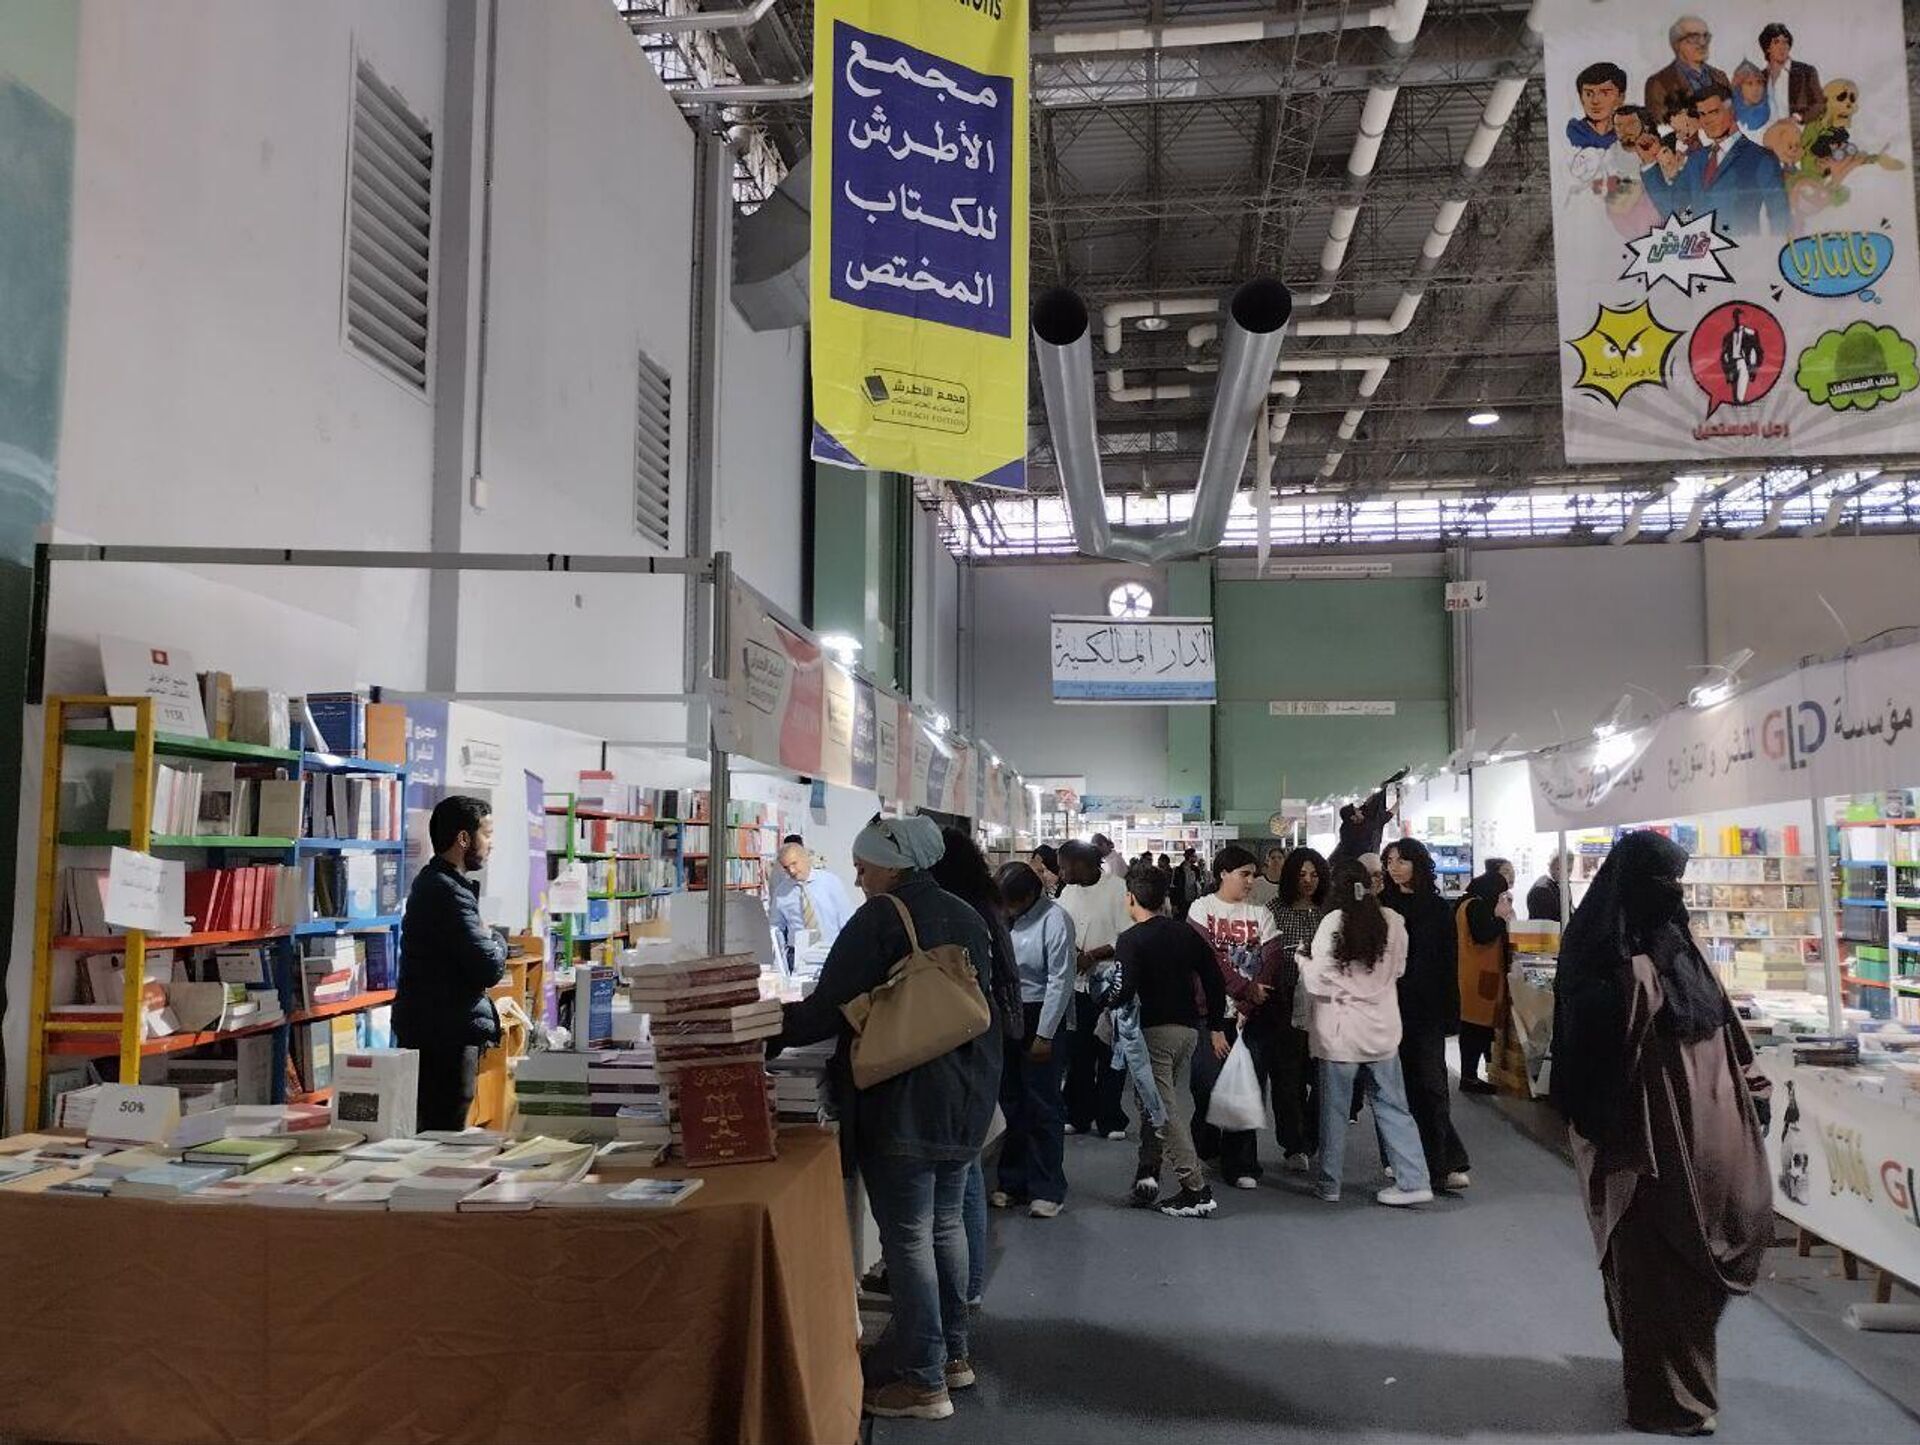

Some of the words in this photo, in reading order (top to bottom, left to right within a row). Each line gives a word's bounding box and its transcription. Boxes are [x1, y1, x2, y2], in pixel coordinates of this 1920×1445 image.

[845, 39, 998, 109] مجمع
[848, 104, 995, 174] الأطرش
[844, 179, 998, 241] للكتاب
[845, 255, 994, 309] المختص
[1788, 231, 1877, 286] فانتازيا
[1447, 598, 1470, 609] RIA
[1056, 627, 1154, 671] المالكية
[1156, 627, 1213, 674] الدار
[1834, 695, 1914, 746] مؤسسة
[119, 1100, 146, 1115] 50%
